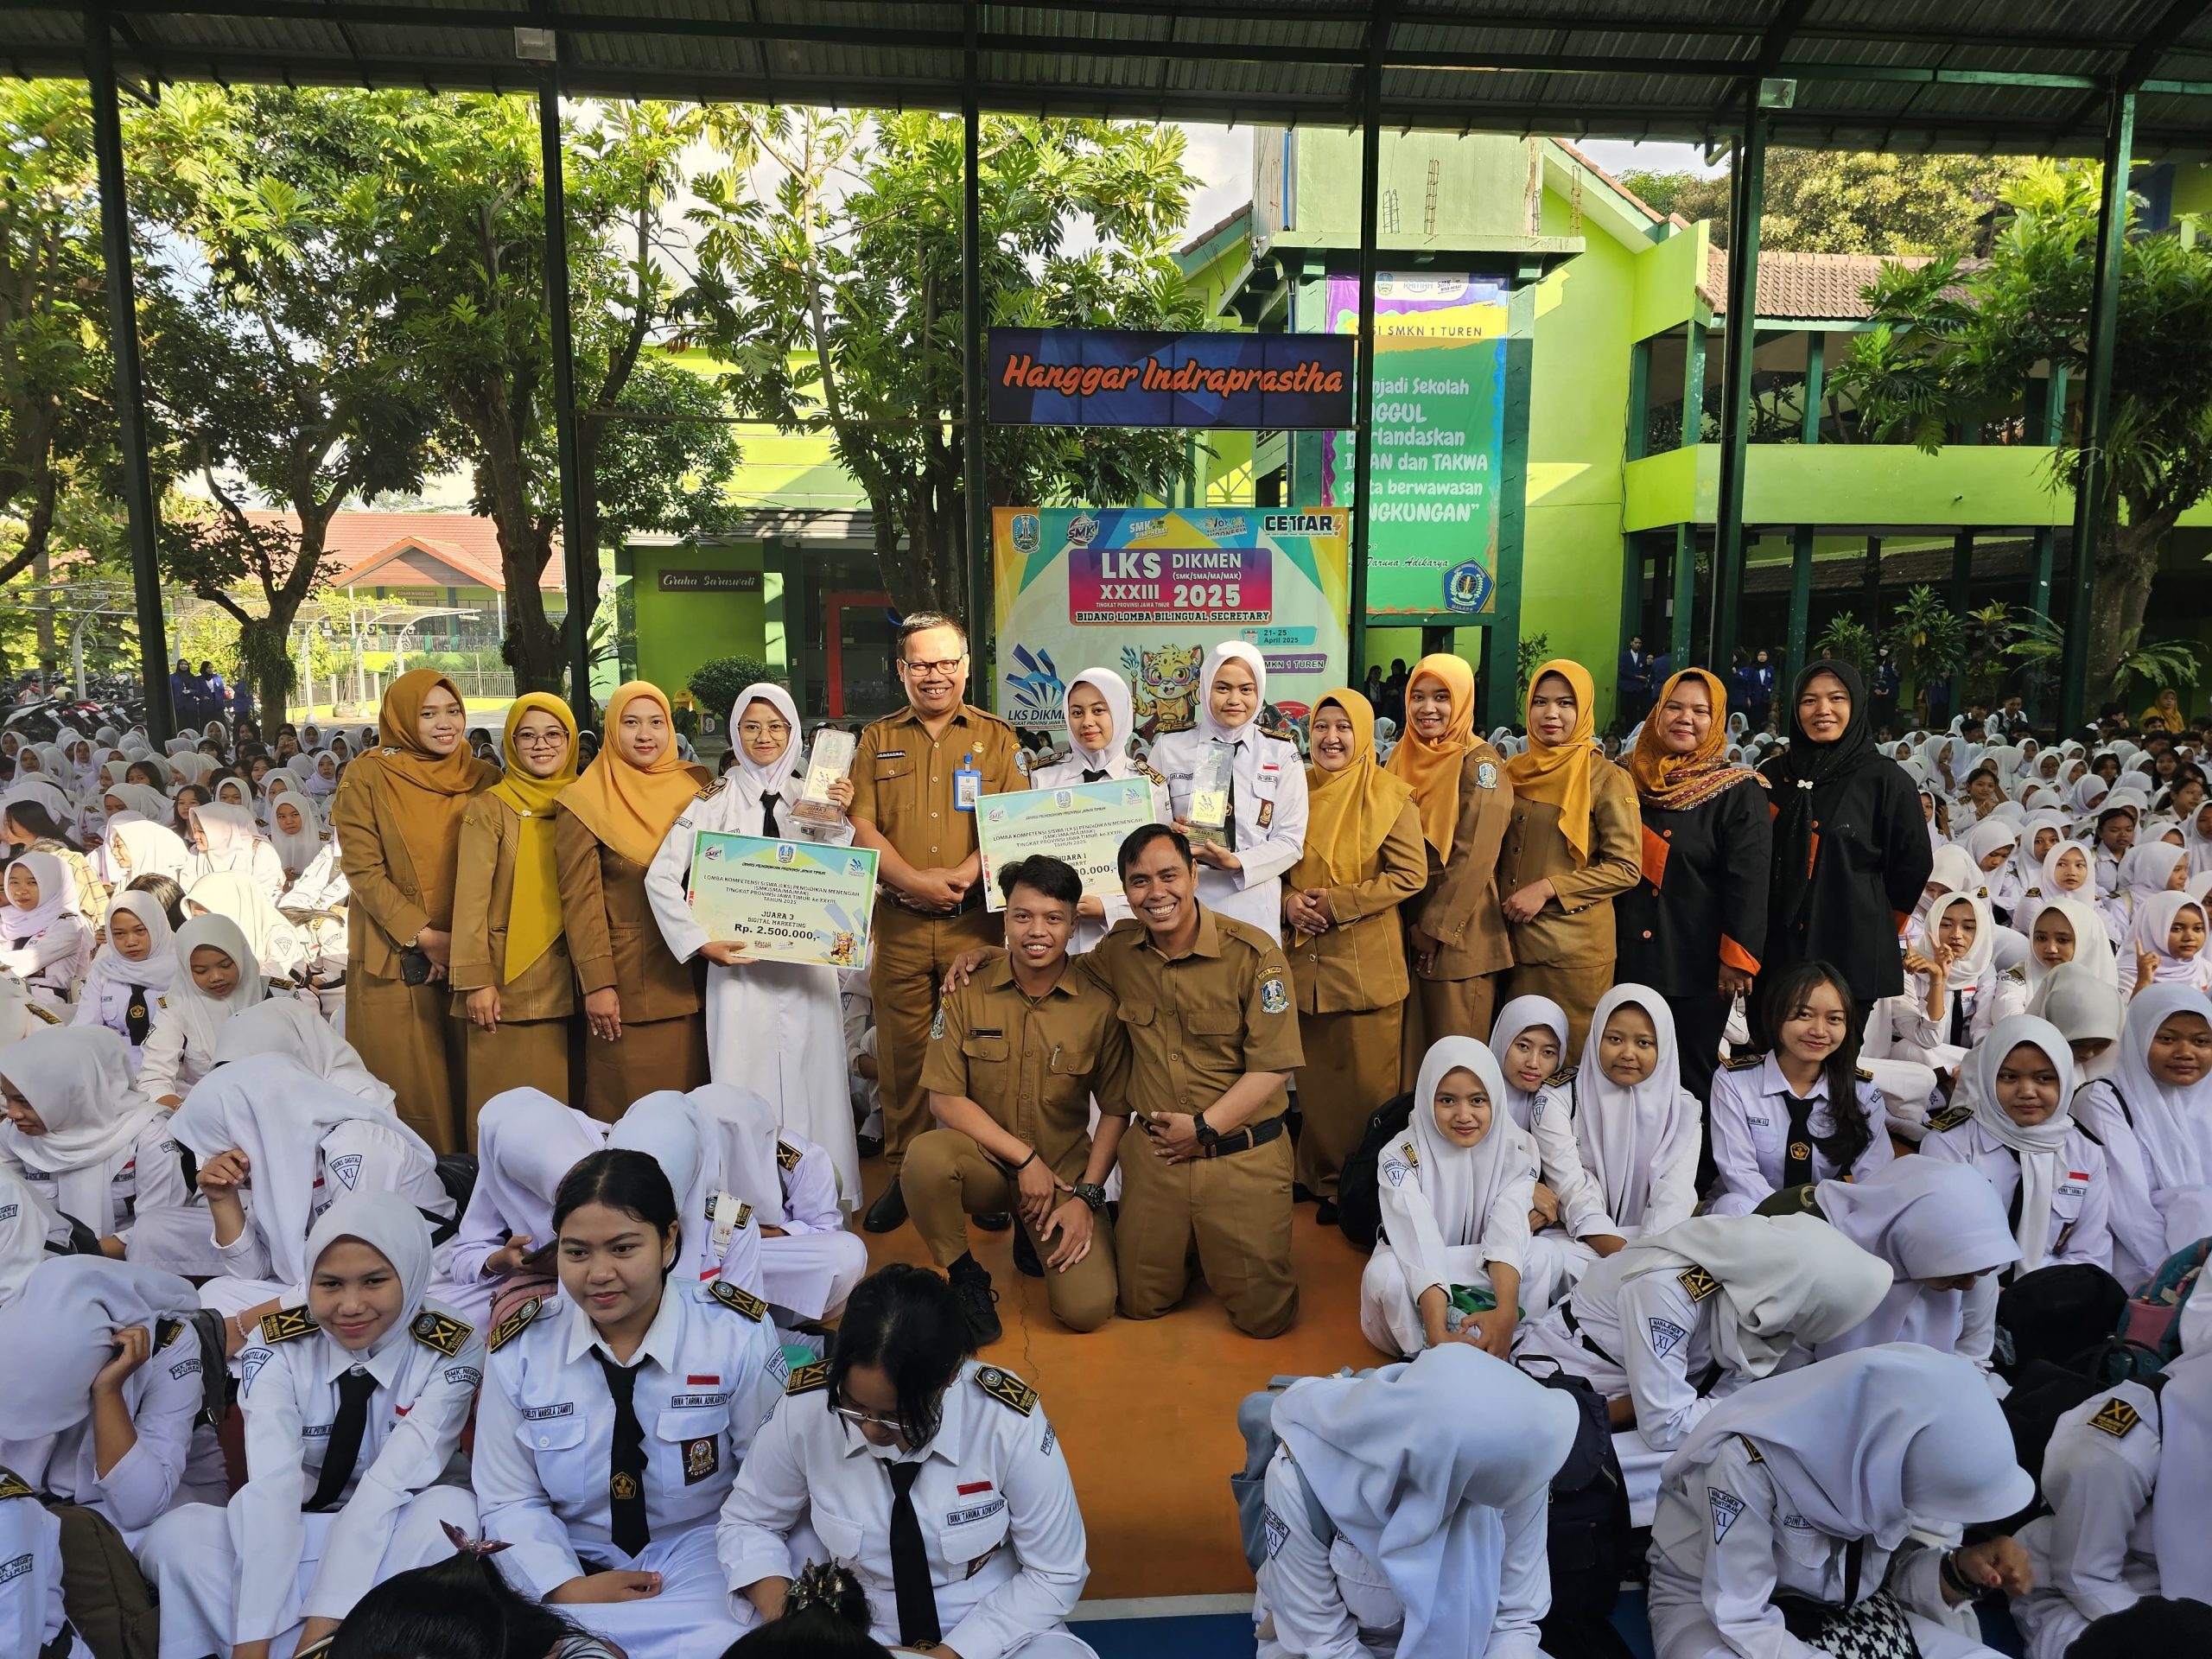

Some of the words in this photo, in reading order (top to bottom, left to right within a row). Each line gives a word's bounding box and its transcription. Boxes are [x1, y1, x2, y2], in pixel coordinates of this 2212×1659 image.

[1389, 326, 1425, 336] SMKN
[1431, 326, 1435, 336] 1
[1441, 327, 1483, 336] TUREN
[1003, 355, 1137, 396] Hanggar
[1142, 358, 1343, 397] Indraprastha
[1413, 378, 1469, 396] Sekolah
[1344, 454, 1393, 471] IAN
[1398, 453, 1427, 471] dan
[1433, 454, 1487, 471] TAKWA
[1388, 480, 1483, 496] berwawasan
[1129, 521, 1151, 532] SMK
[1102, 552, 1161, 579] LKS
[1173, 554, 1242, 569] DIKMEN
[1403, 556, 1449, 570] Adikarya
[663, 575, 697, 586] Graha
[1173, 572, 1242, 581] (SMK/SMA/MA/MAK)
[1100, 585, 1160, 600] XXXIII
[1173, 584, 1241, 607] 2025
[1077, 612, 1115, 622] BIDANG
[1116, 612, 1152, 621] LOMBA
[1154, 612, 1208, 621] BILINGUAL
[1211, 611, 1269, 621] SECRETARY
[1265, 660, 1284, 669] MKN
[1294, 660, 1325, 669] TUREN
[1008, 710, 1028, 721] LKS
[1031, 709, 1065, 721] DIKM
[725, 877, 760, 886] KOMPETENSI
[761, 911, 786, 919] JUARA
[734, 924, 753, 934] Rp.
[343, 1168, 354, 1179] XI
[1391, 1171, 1400, 1180] XI
[1691, 1269, 1715, 1291] XI
[731, 1290, 754, 1311] XI
[264, 1319, 274, 1337] TUREN
[279, 1310, 305, 1333] XI
[1653, 1319, 1681, 1333] MANAJEMEN
[429, 1320, 457, 1345] XI
[451, 1332, 467, 1349] TUREN
[1656, 1335, 1669, 1349] XI
[447, 1369, 461, 1377] SMK
[452, 1374, 478, 1383] TUREN
[779, 1365, 789, 1381] XI
[804, 1363, 826, 1384] XI
[998, 1376, 1025, 1402] XI
[686, 1396, 702, 1405] TARUNA
[2103, 1400, 2135, 1422] XI
[950, 1514, 961, 1523] BINA
[963, 1510, 980, 1521] TARUNA
[1715, 1510, 1727, 1527] XI
[1787, 1516, 1800, 1525] DINI
[1268, 1528, 1278, 1548] XI
